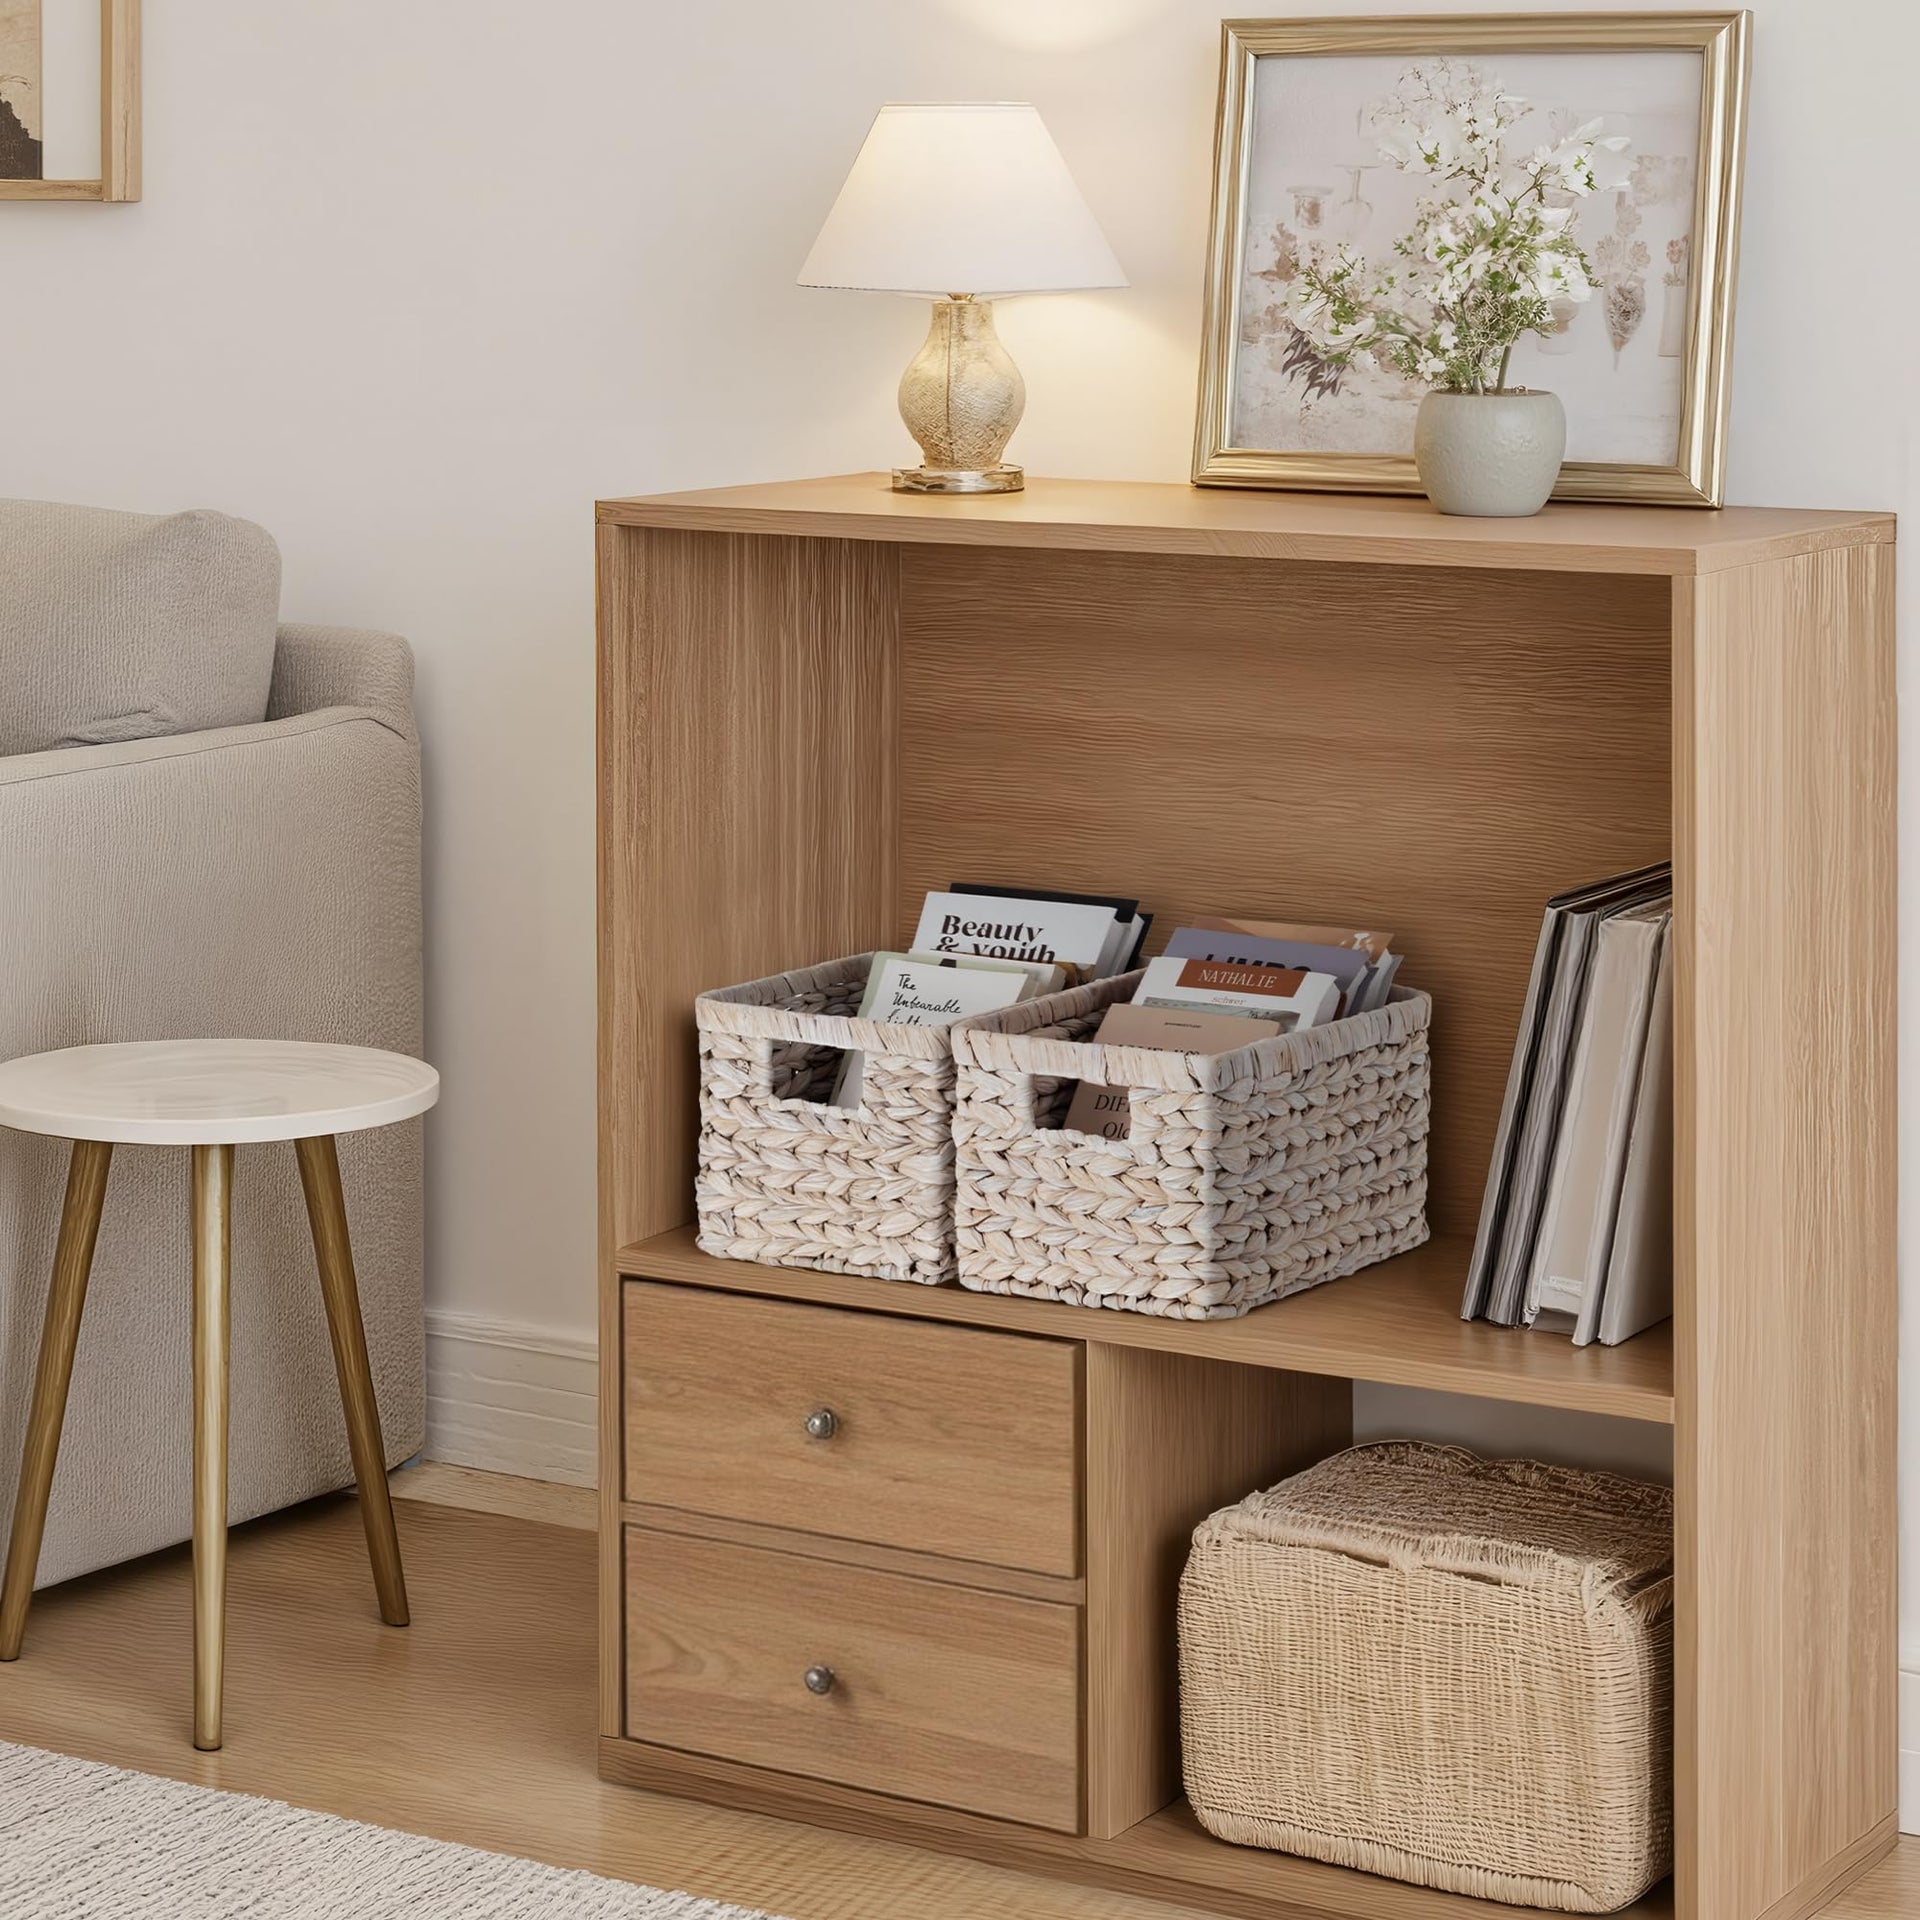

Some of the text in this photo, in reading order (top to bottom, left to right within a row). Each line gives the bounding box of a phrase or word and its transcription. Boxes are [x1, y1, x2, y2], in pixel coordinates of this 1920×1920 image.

[941, 914, 1044, 944] Beauty
[898, 973, 917, 991] The
[1198, 969, 1278, 989] NATHALIE
[892, 992, 962, 1014] Unbearable
